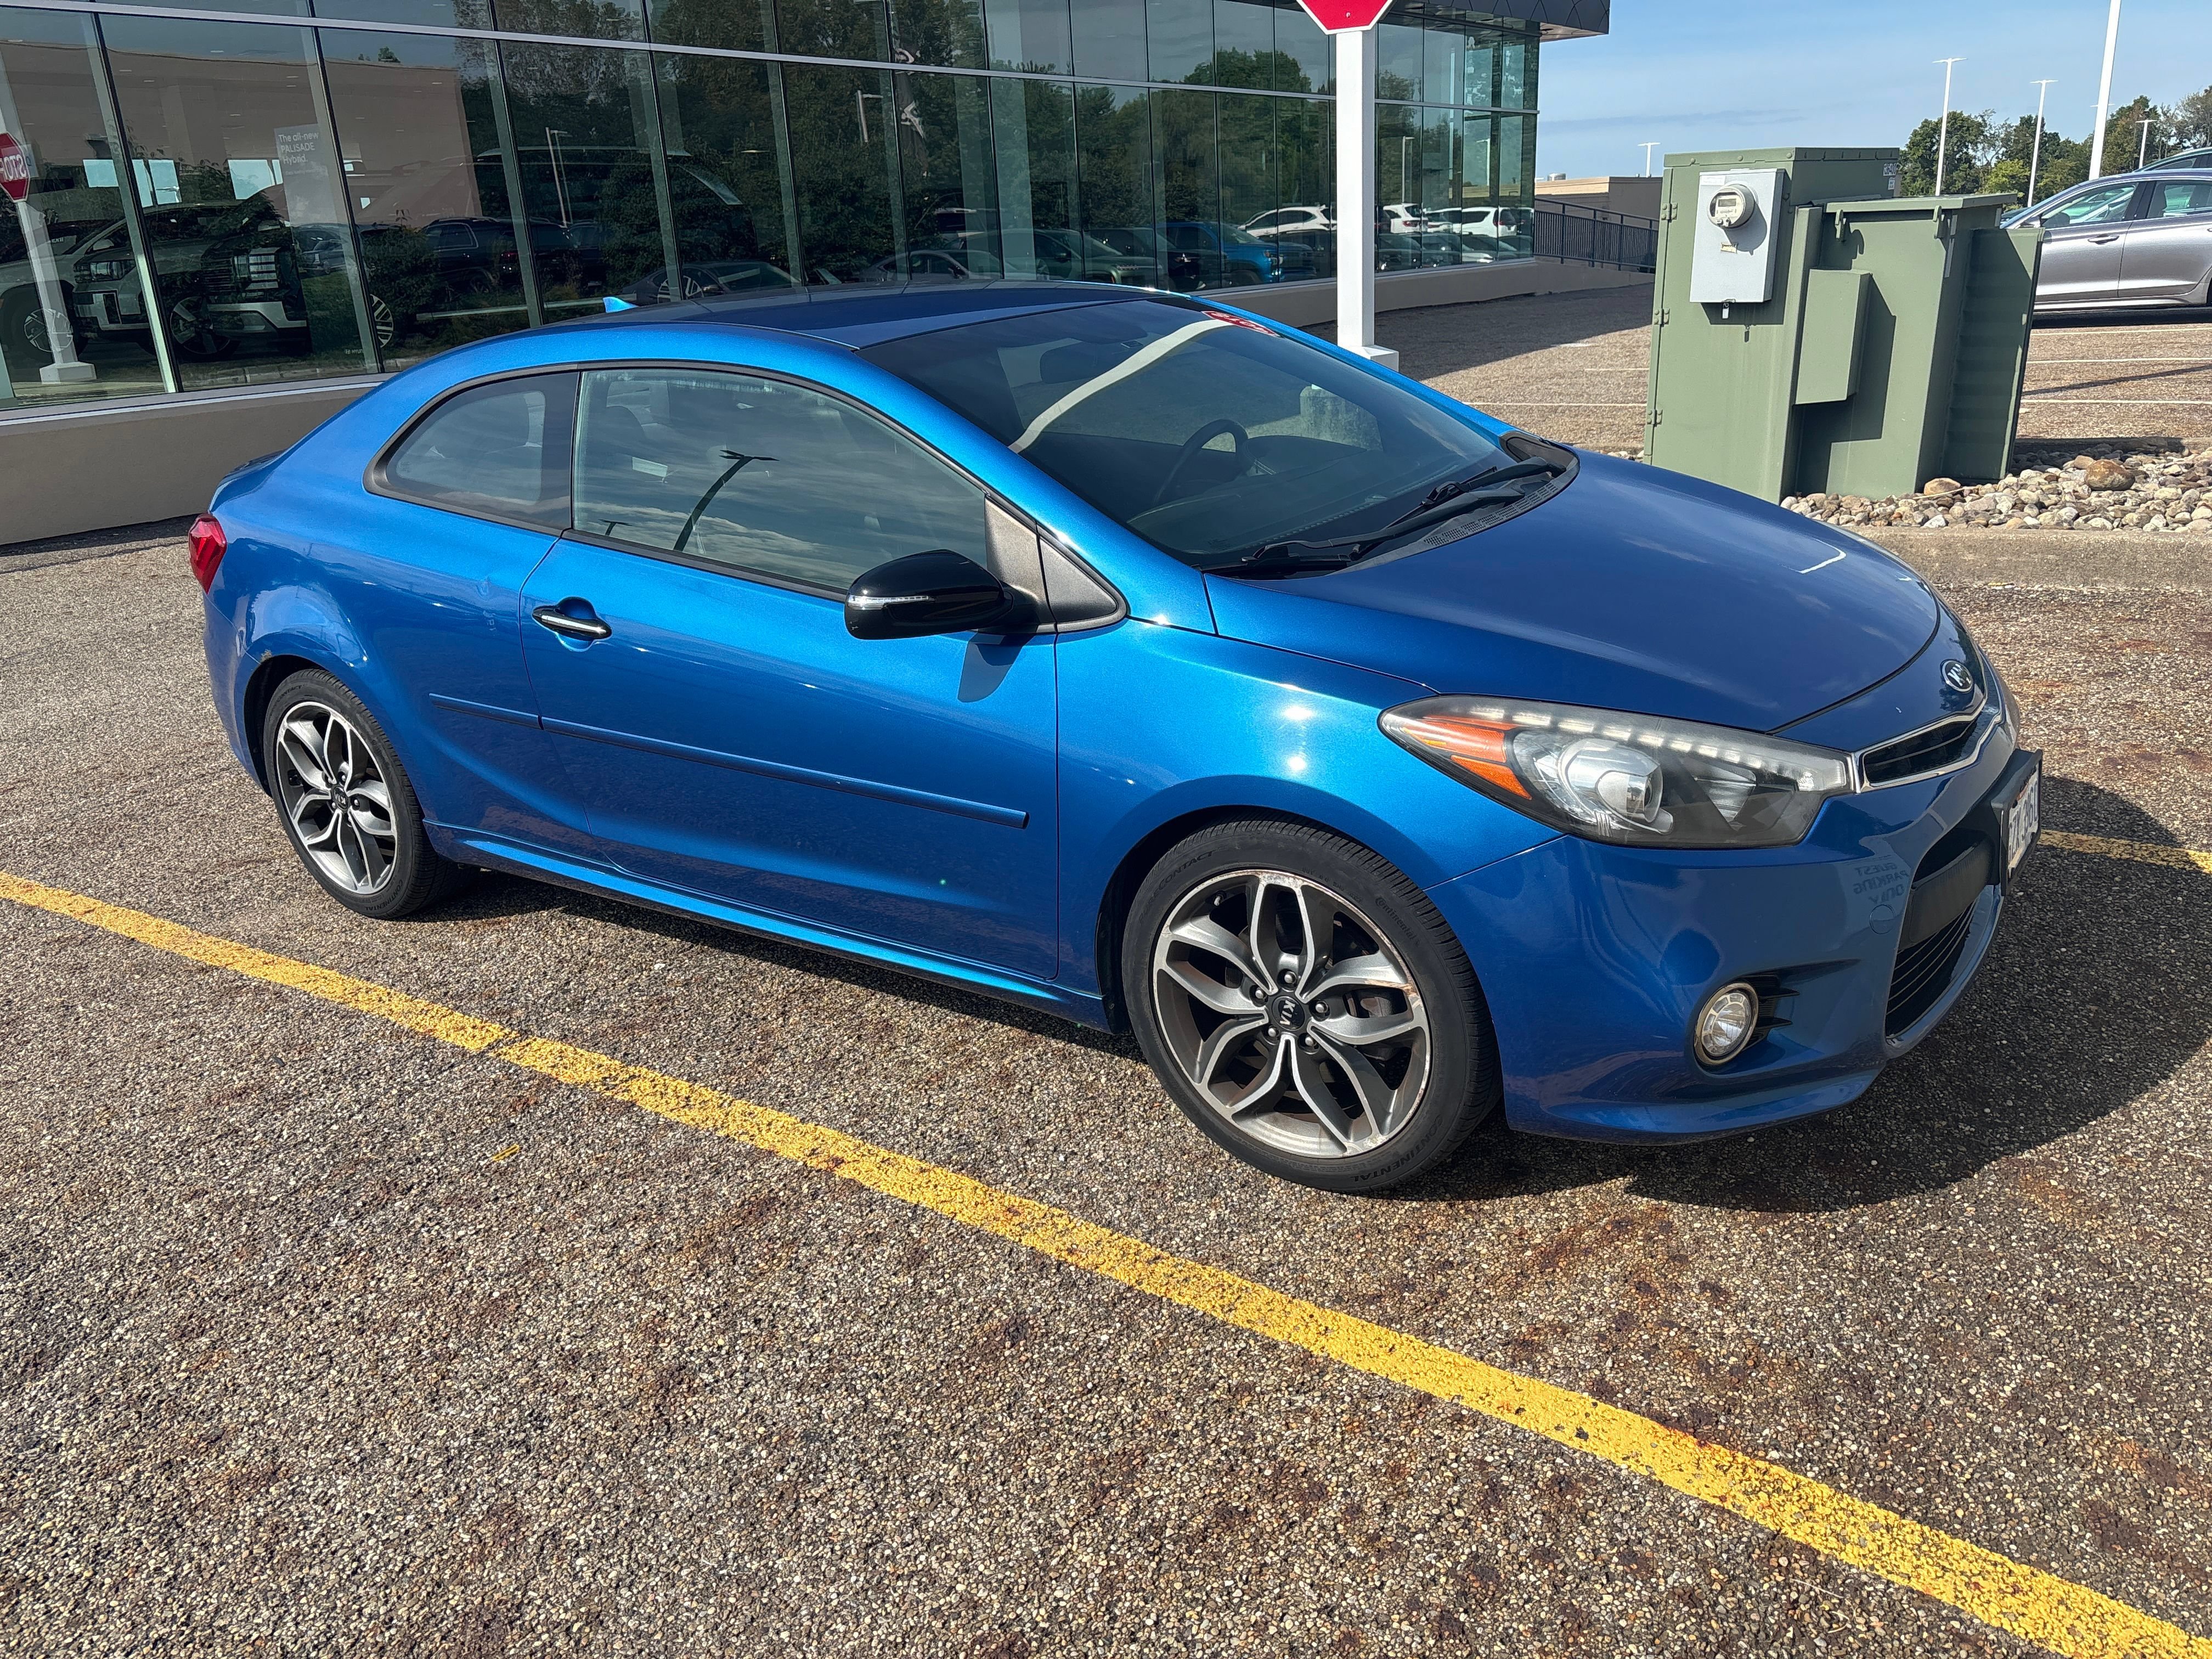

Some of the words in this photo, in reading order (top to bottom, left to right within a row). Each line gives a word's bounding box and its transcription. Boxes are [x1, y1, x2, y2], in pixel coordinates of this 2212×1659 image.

[278, 134, 292, 143] The
[292, 132, 319, 141] all-new
[281, 143, 316, 153] PALISADE
[364, 879, 403, 911] CONTINENTAL
[1279, 1000, 1296, 1025] KIA
[1350, 1114, 1443, 1182] CONTINENTAL
